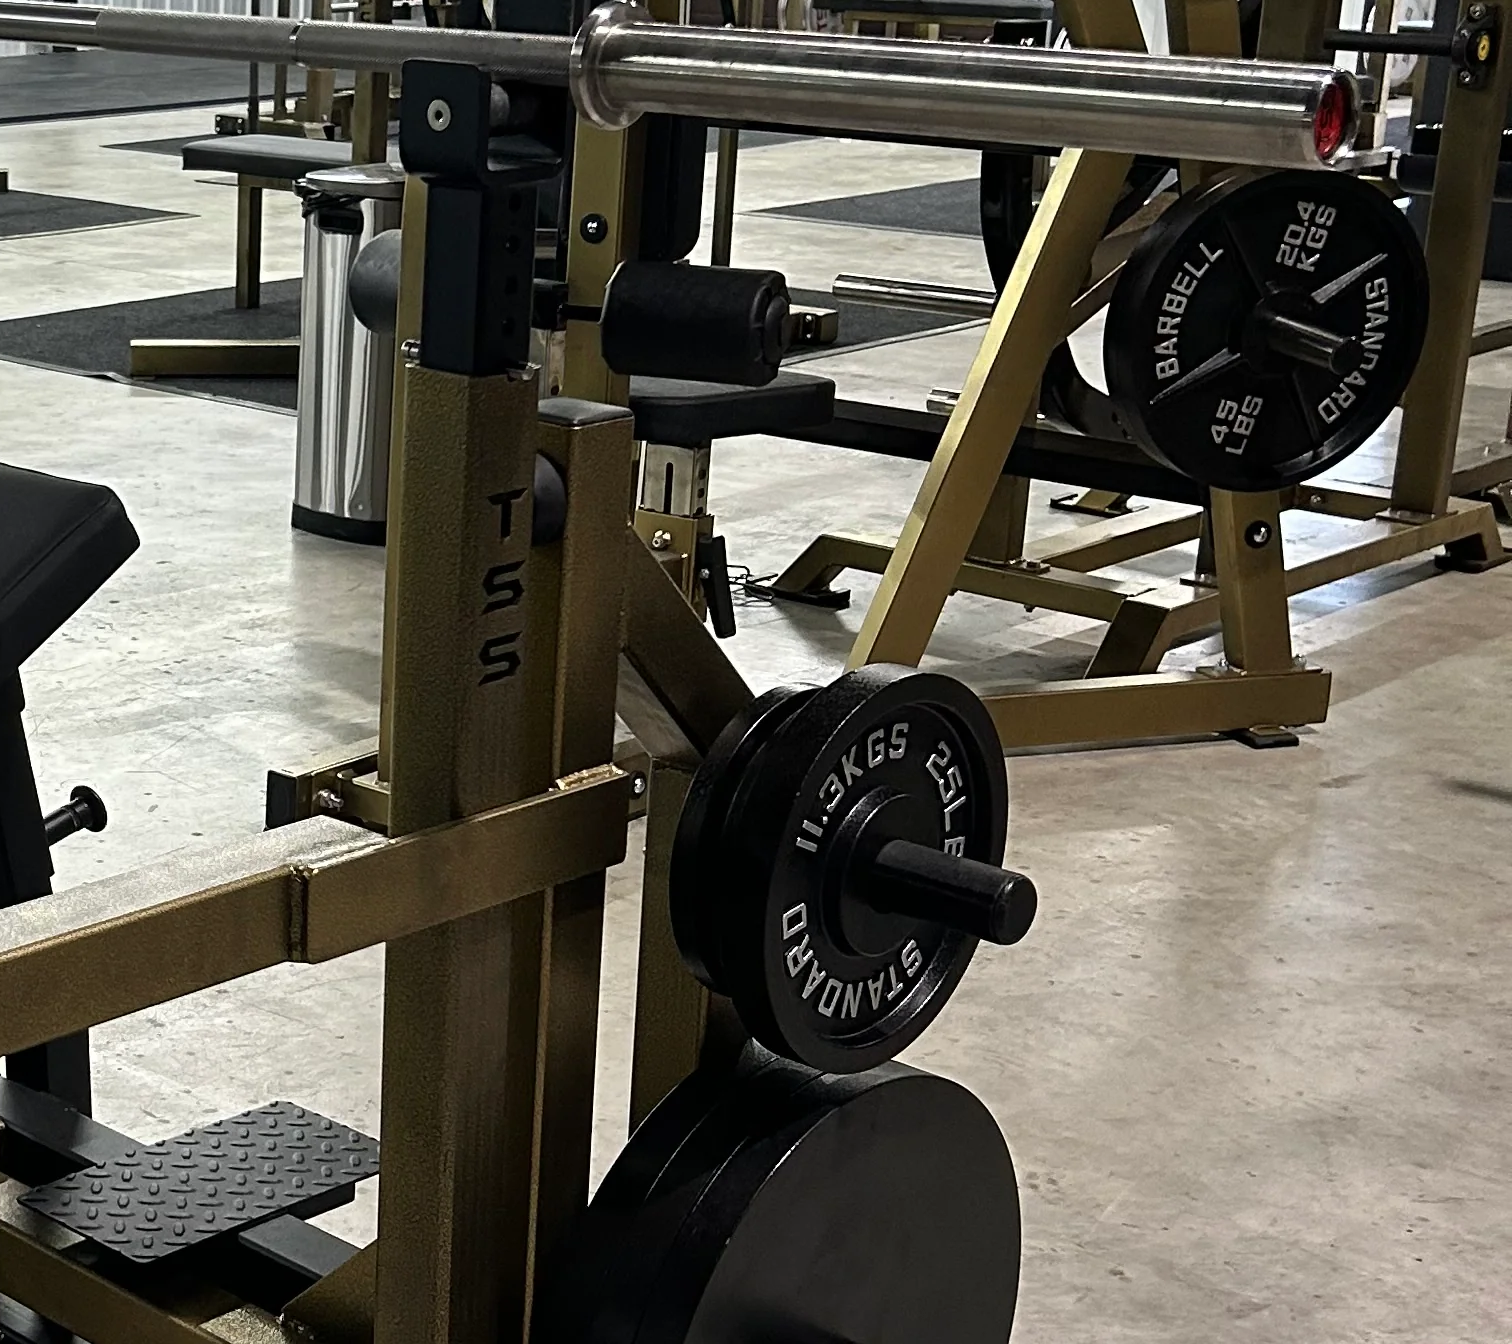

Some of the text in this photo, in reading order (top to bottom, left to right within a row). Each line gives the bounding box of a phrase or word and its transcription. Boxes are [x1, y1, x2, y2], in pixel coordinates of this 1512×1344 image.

[1276, 201, 1316, 267] 20.4
[1296, 205, 1337, 272] KGS
[1153, 242, 1225, 380] BARBELL
[1317, 277, 1390, 424] STANDARD
[1210, 399, 1238, 444] 45
[1225, 395, 1264, 456] LBS
[478, 487, 529, 688] TSS
[795, 722, 910, 853] 11.3KGS
[782, 902, 924, 1020] STANDARD
